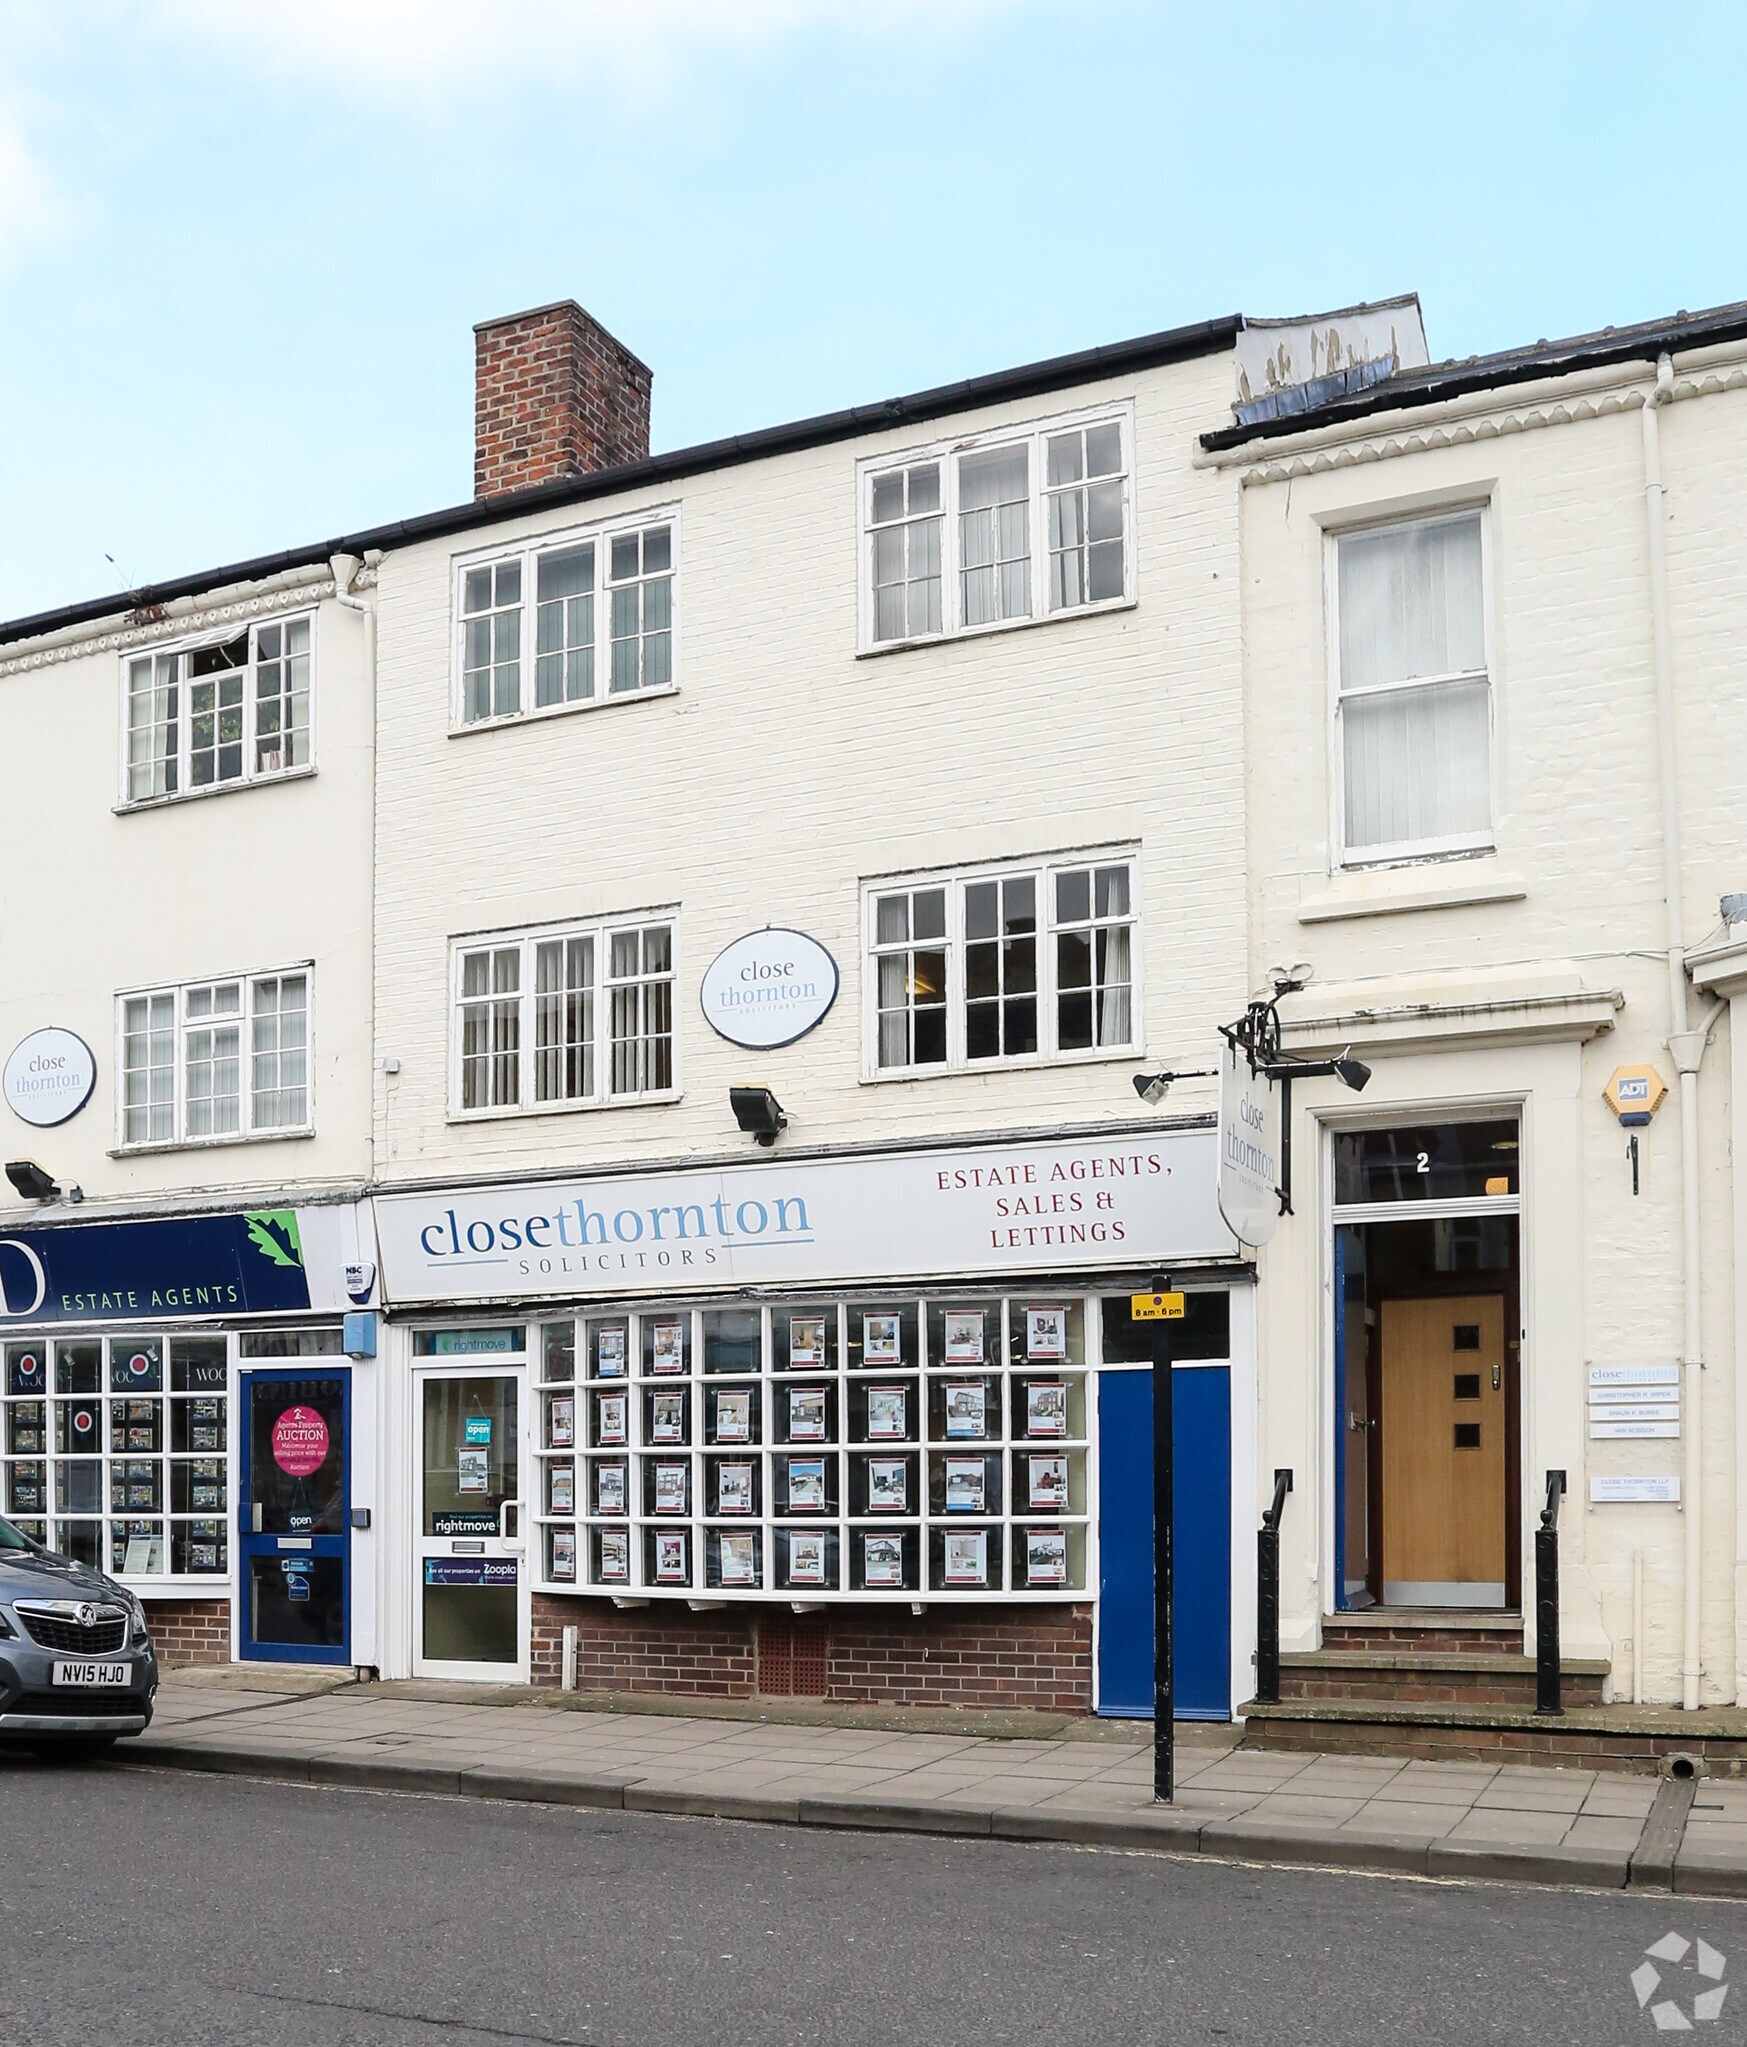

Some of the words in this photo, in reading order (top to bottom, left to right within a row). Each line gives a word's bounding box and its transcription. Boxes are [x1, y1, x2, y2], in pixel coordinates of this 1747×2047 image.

[740, 961, 795, 982] close
[720, 981, 816, 1007] thornton
[29, 1055, 66, 1072] close
[16, 1073, 80, 1093] thornton
[1619, 1082, 1648, 1096] ADT
[1240, 1092, 1264, 1133] close
[1227, 1123, 1275, 1183] thornton
[1416, 1152, 1430, 1173] 2
[937, 1164, 1037, 1190] ESTATE
[1049, 1154, 1173, 1182] AGENTS,
[996, 1193, 1083, 1217] SALES
[1096, 1191, 1115, 1210] &
[990, 1221, 1127, 1249] LETTINGS
[519, 1247, 718, 1275] SOLICITORS
[62, 1291, 137, 1312] ESTATE
[151, 1285, 238, 1306] AGENTS
[1135, 1309, 1141, 1317] 8
[1161, 1307, 1167, 1315] 6
[454, 1338, 506, 1353] rightmove
[276, 1430, 324, 1440] AUCTION
[467, 1426, 489, 1435] open
[290, 1516, 312, 1527] open
[435, 1520, 496, 1534] rightmove
[483, 1563, 517, 1576] Zoopla
[62, 1664, 95, 1682] NV15
[99, 1665, 124, 1683] HJO
